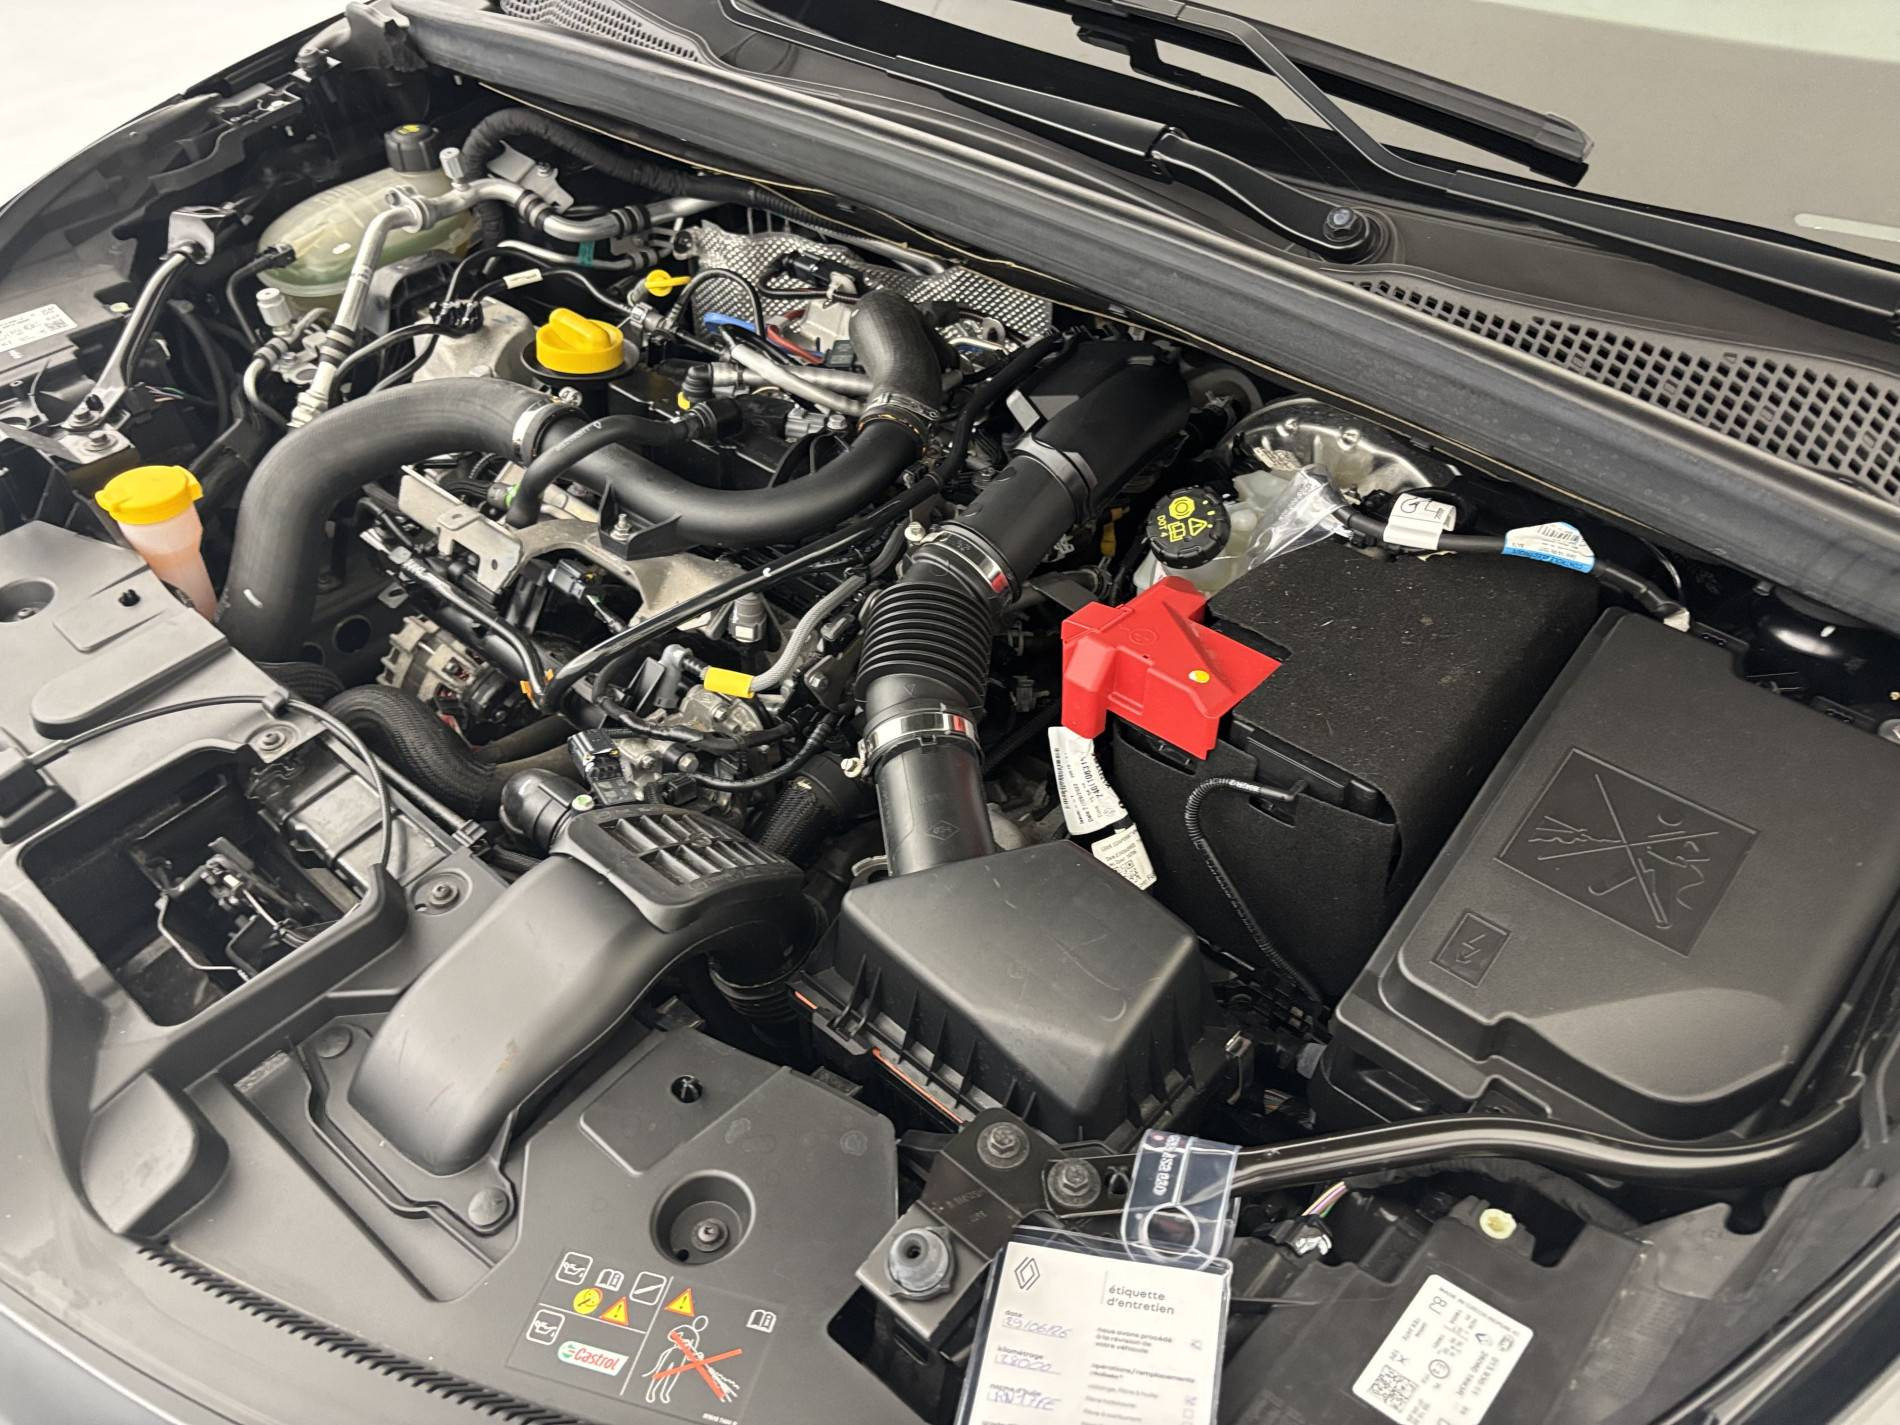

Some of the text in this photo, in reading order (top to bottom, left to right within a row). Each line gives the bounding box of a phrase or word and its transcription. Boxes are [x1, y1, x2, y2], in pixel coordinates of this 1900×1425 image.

[1157, 514, 1168, 530] DOT
[1109, 1284, 1166, 1301] étiquette
[1107, 1297, 1175, 1316] d'entretien
[574, 1347, 620, 1370] Castrol
